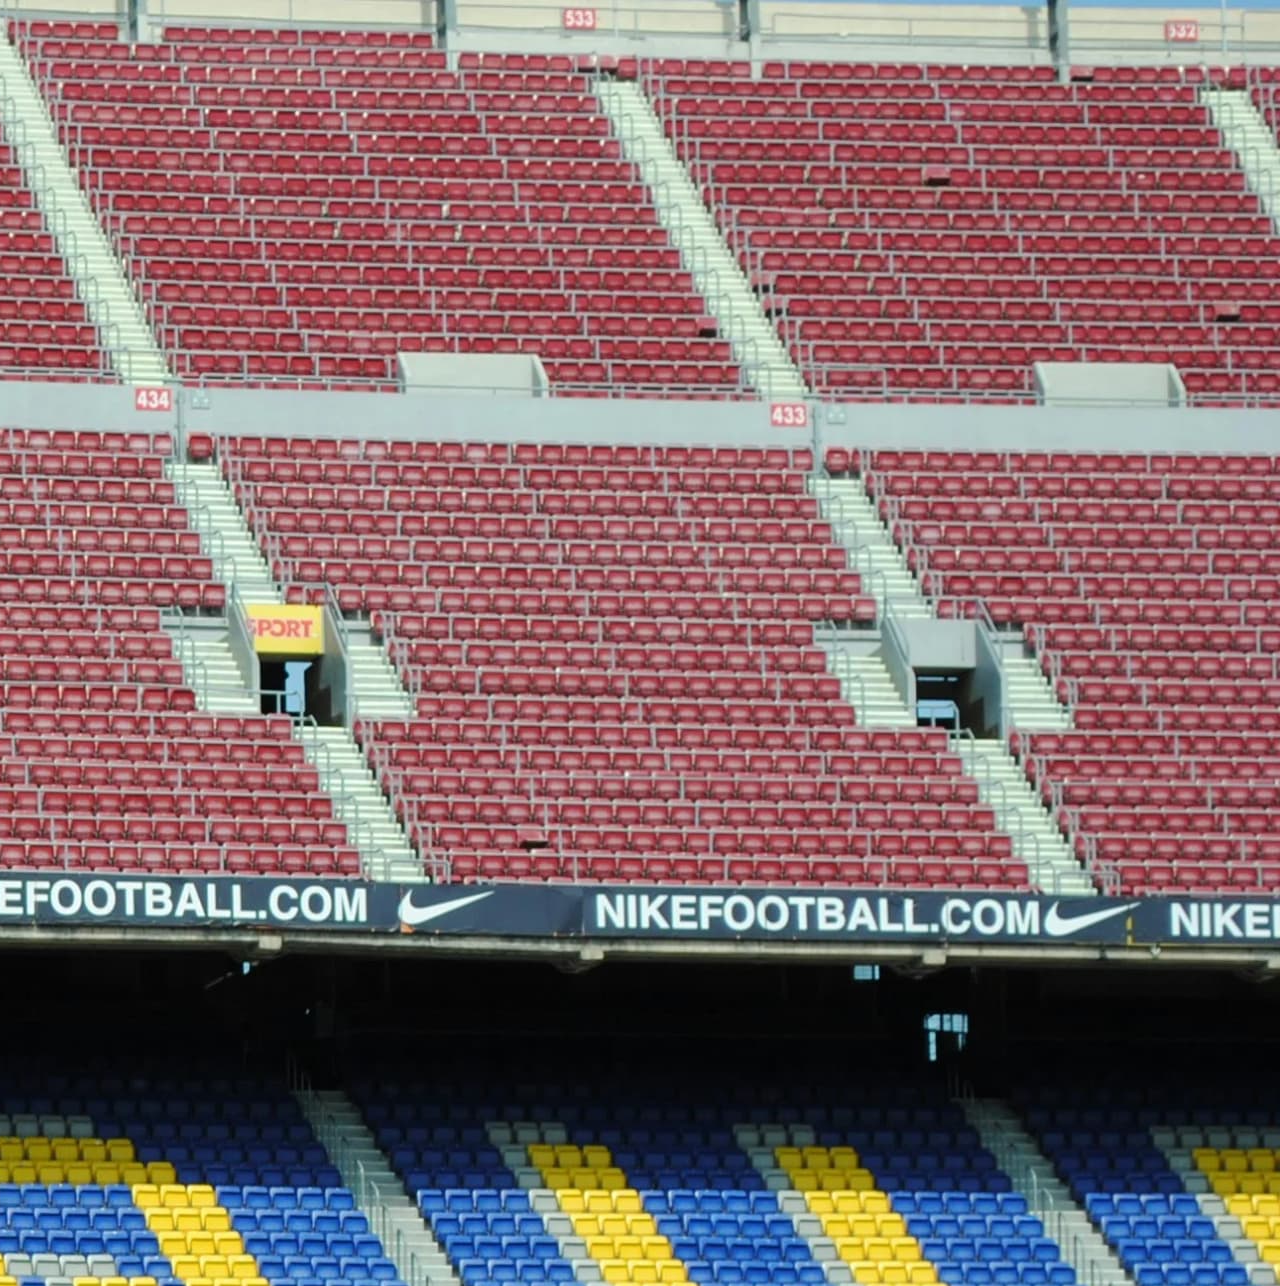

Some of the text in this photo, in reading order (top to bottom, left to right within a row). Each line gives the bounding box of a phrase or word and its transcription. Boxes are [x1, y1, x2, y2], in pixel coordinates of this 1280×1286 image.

[135, 390, 170, 409] 434
[772, 405, 805, 425] 433
[596, 894, 1040, 934] NIKEFOOTBALL.COM
